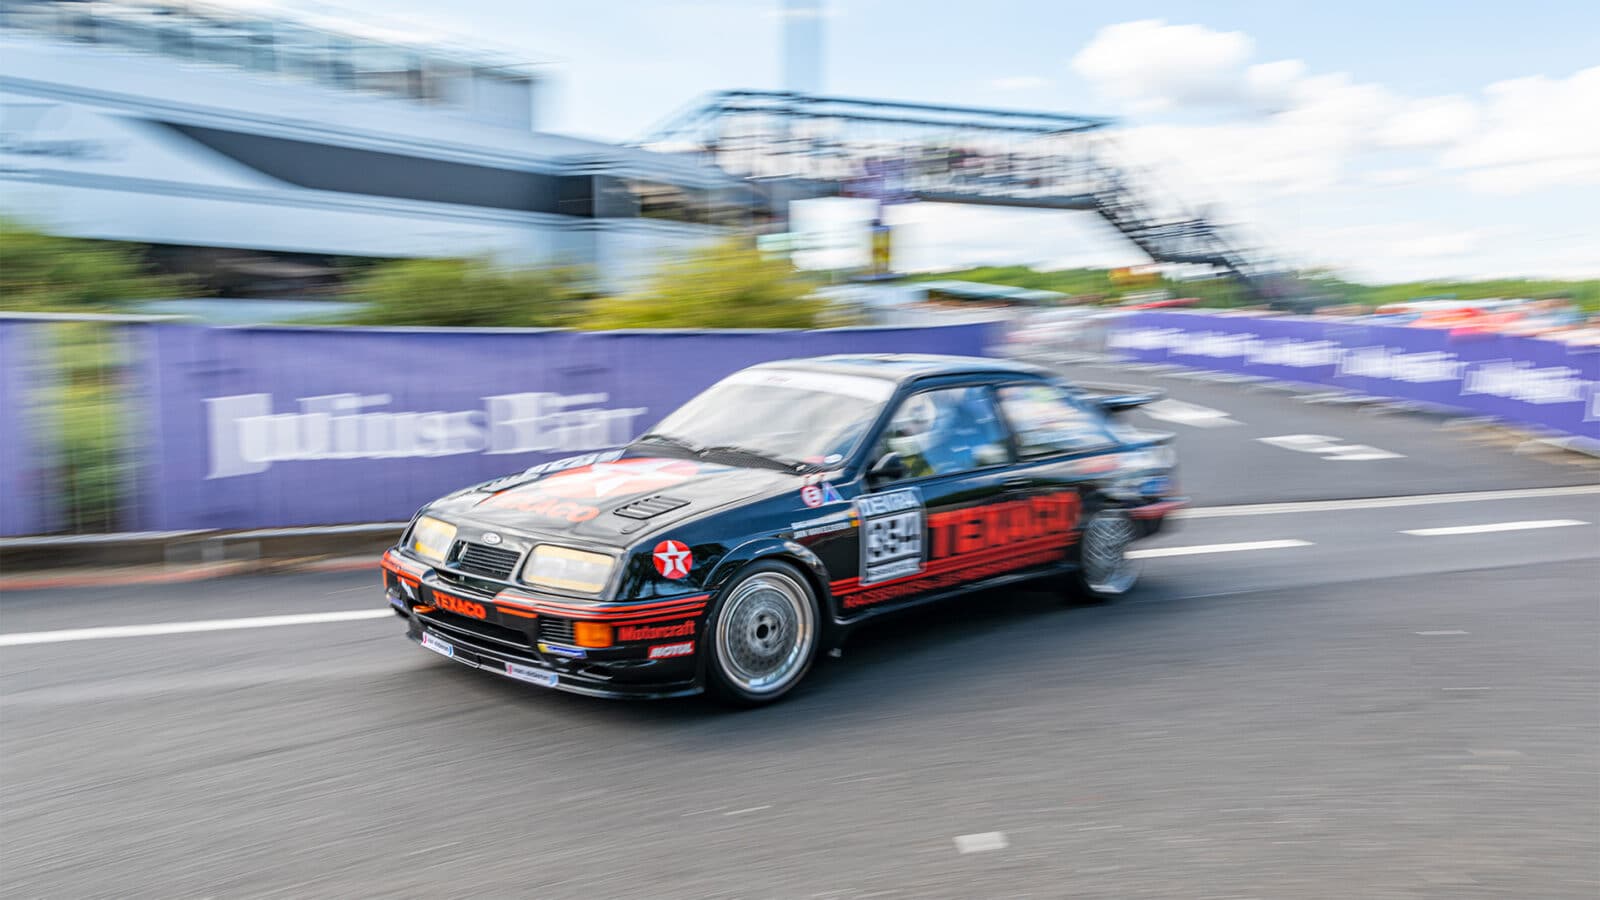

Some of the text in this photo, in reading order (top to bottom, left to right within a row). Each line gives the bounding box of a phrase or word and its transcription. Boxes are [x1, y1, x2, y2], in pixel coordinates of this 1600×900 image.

[927, 491, 1081, 558] TEXACO
[432, 590, 487, 620] TEXACO
[618, 620, 696, 641] Motorcraft
